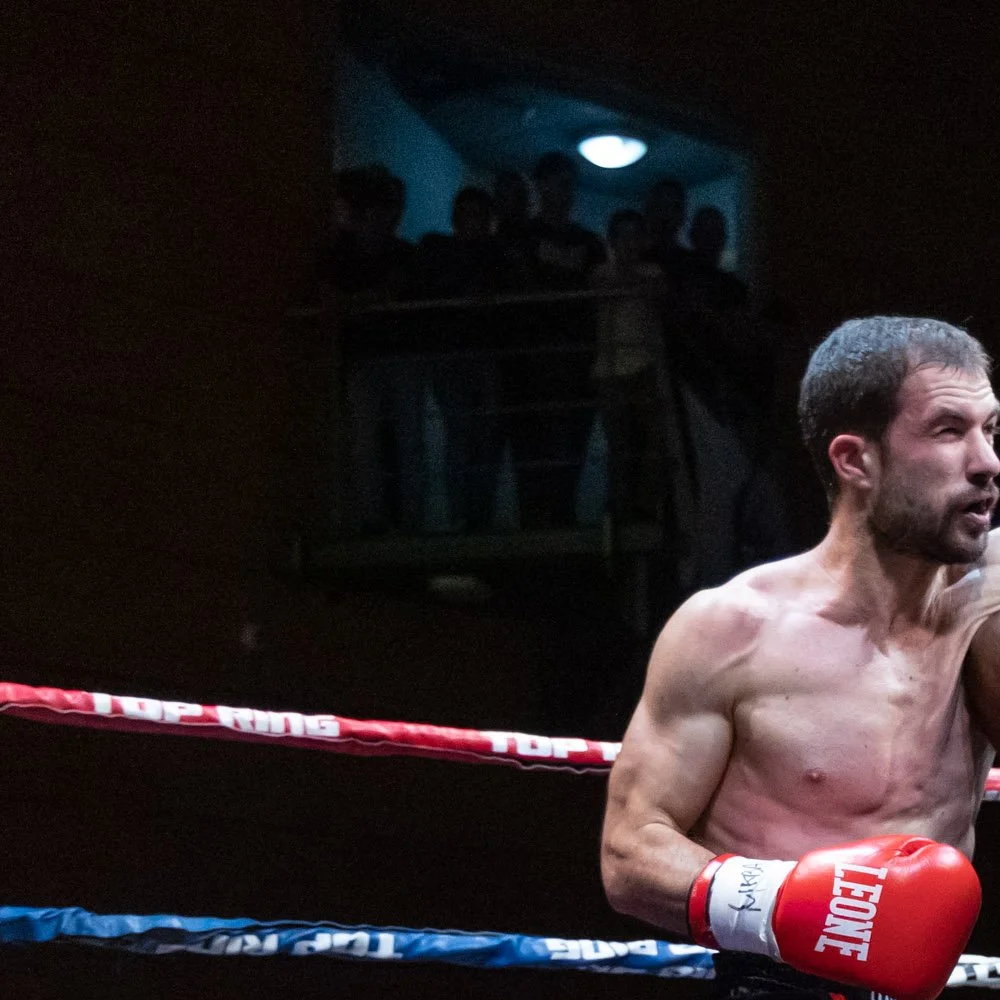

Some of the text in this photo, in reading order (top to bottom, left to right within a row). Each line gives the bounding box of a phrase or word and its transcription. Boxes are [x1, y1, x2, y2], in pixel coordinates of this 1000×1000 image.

[92, 691, 339, 738] TOP RING
[478, 730, 588, 760] TOP
[814, 862, 888, 962] LEONE
